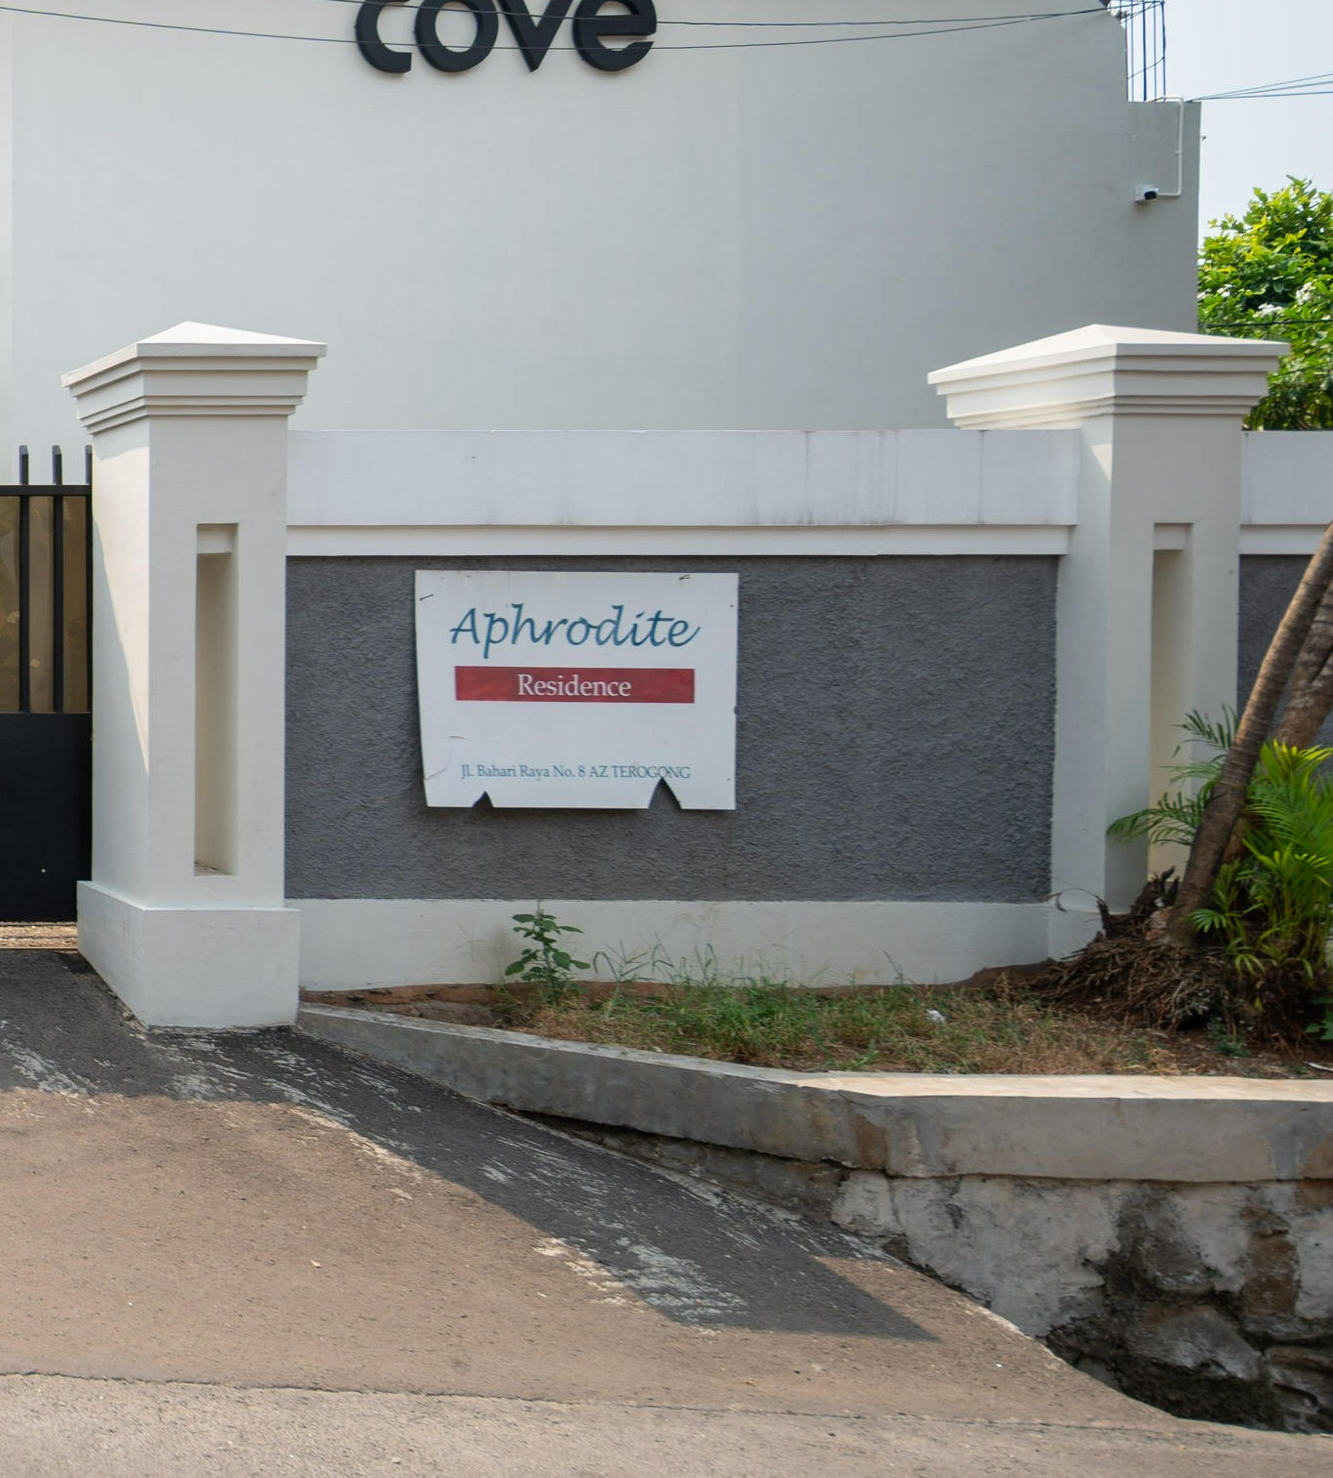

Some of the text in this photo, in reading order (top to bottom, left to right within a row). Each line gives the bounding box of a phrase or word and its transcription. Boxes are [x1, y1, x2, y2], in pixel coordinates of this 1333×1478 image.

[449, 602, 701, 659] Aphrodite
[517, 673, 632, 697] Residence
[477, 764, 516, 777] Bahari
[519, 764, 550, 781] Raya
[552, 764, 575, 778] No.
[578, 765, 586, 778] 8
[589, 765, 609, 778] AZ
[610, 765, 692, 779] TEROGONG
